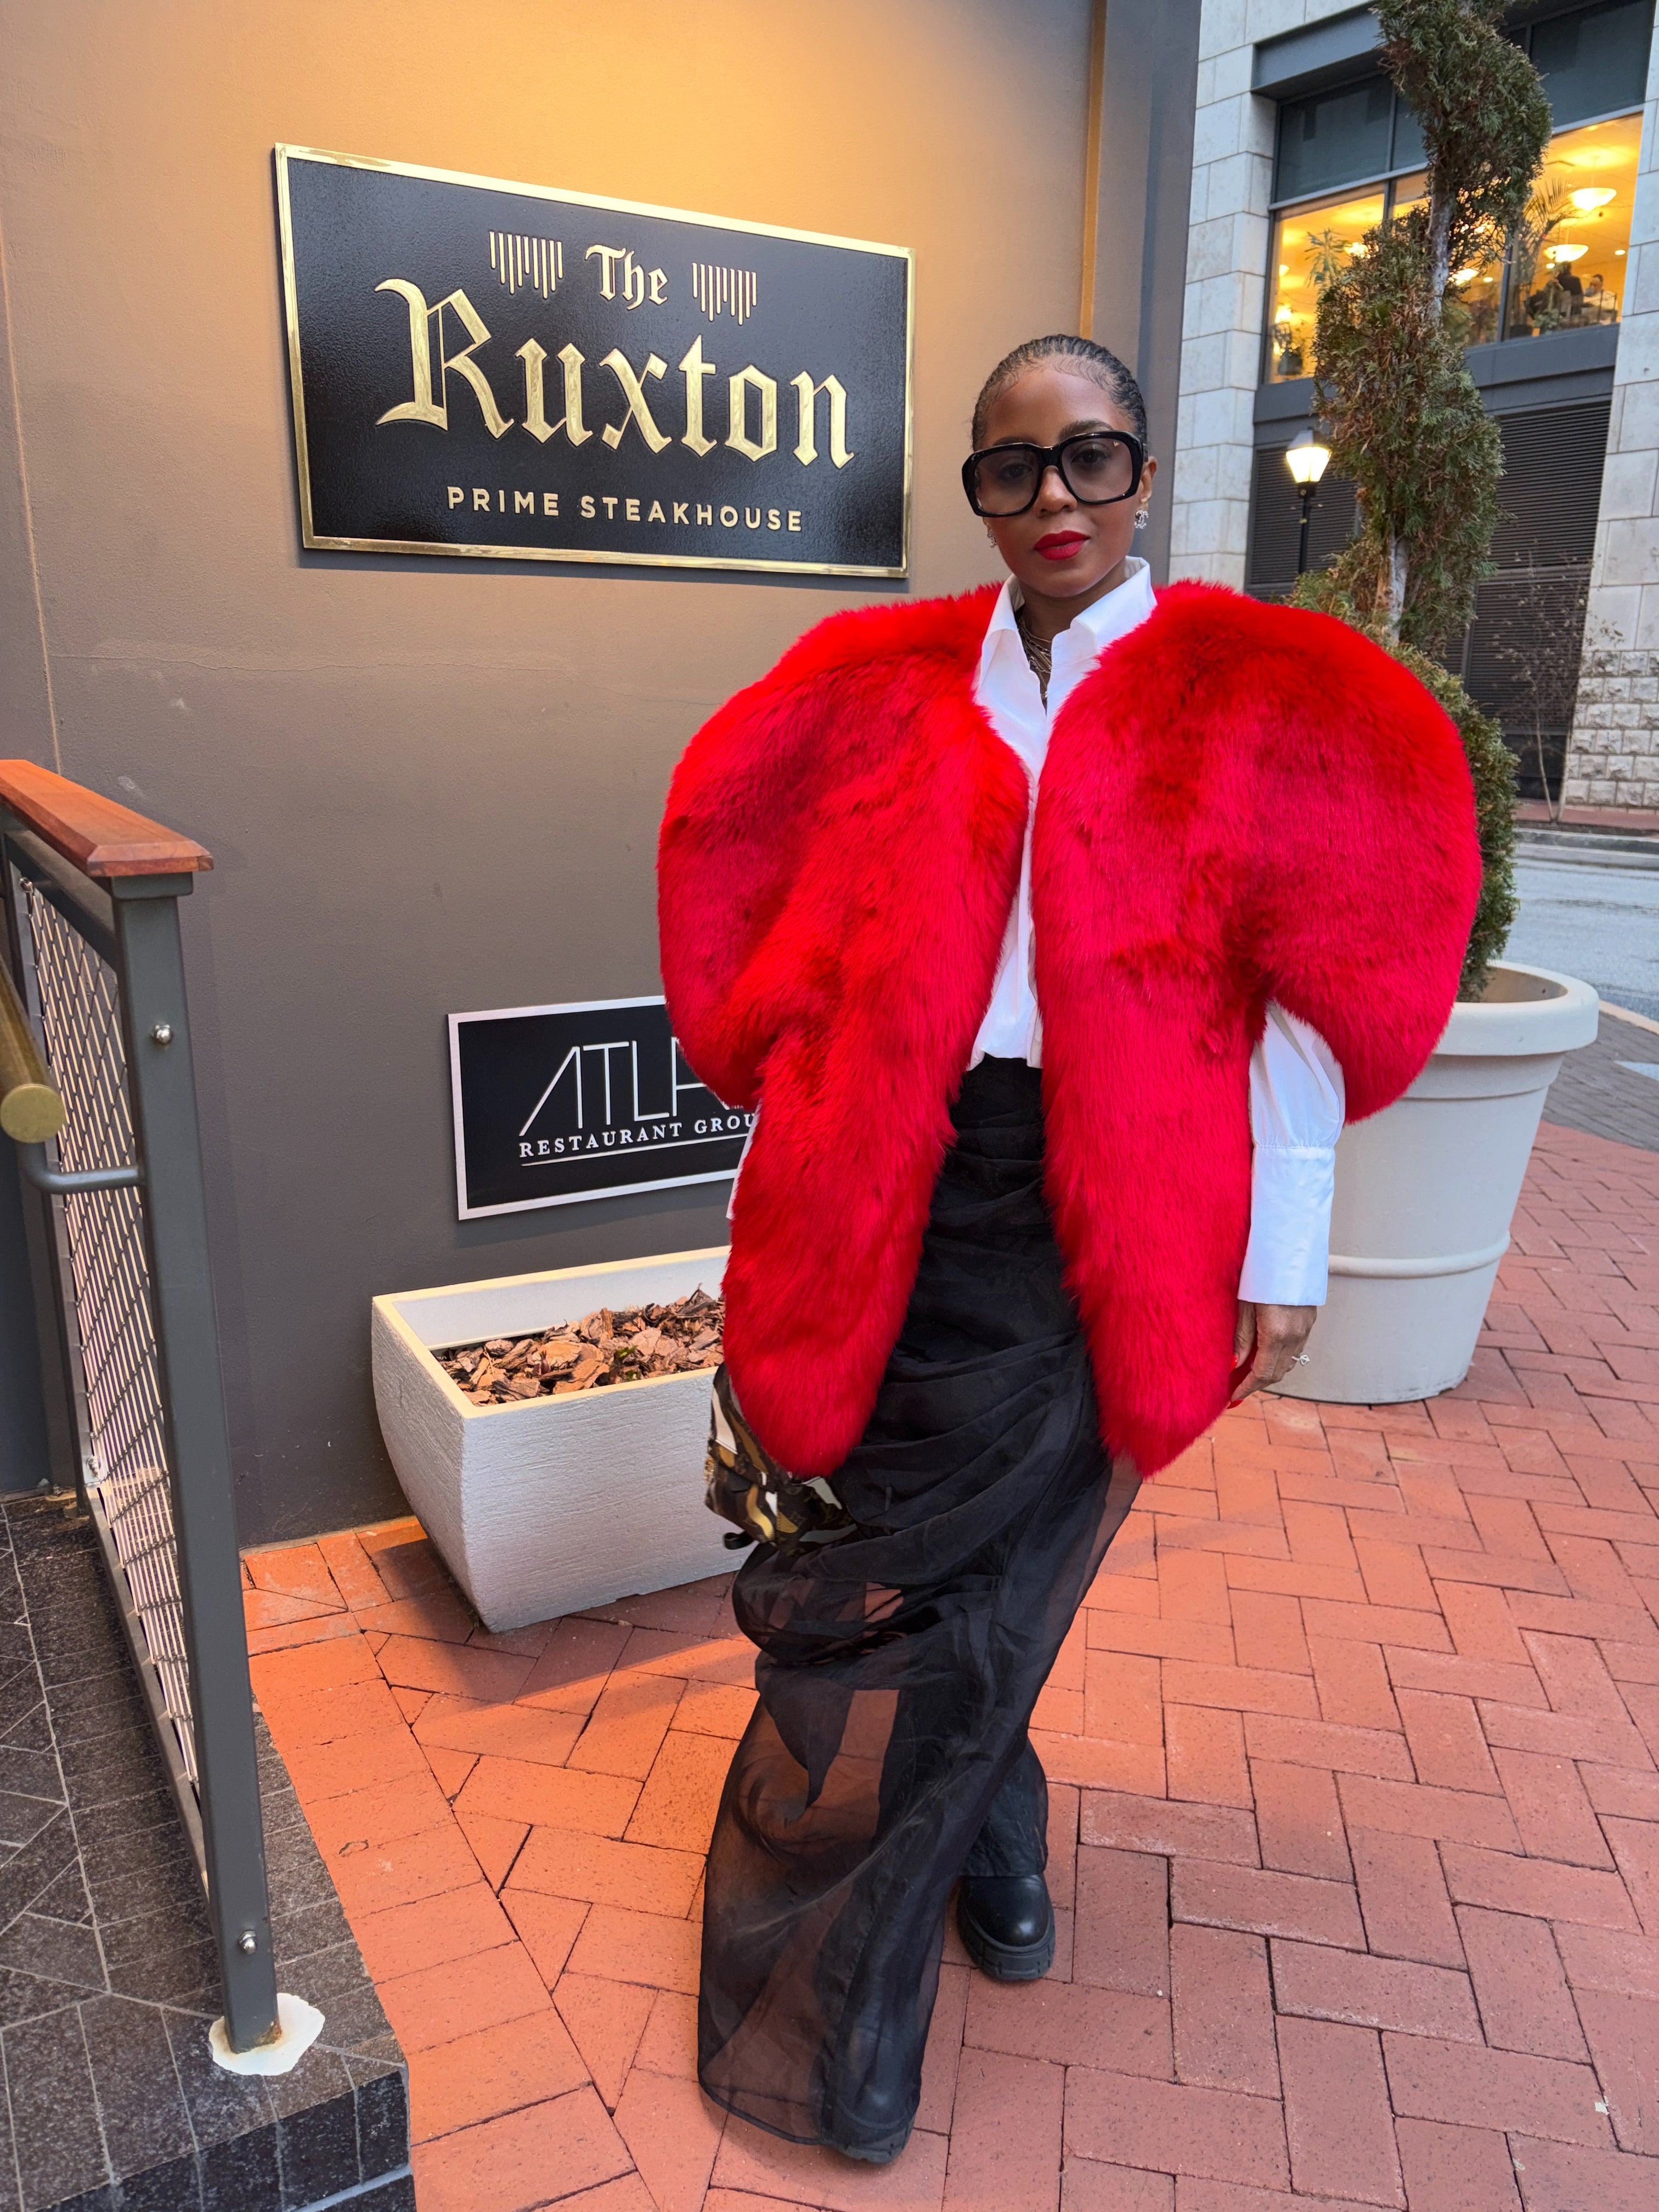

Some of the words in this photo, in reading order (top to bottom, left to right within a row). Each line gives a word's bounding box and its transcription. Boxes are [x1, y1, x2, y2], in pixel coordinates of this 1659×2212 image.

[584, 244, 669, 311] The
[374, 278, 855, 470] Ruxton
[447, 486, 559, 517] PRIME
[580, 495, 803, 532] STEAKHOUSE
[518, 1036, 744, 1136] ATLA
[518, 1122, 682, 1158] RESTAURANT
[694, 1113, 755, 1134] GROU
